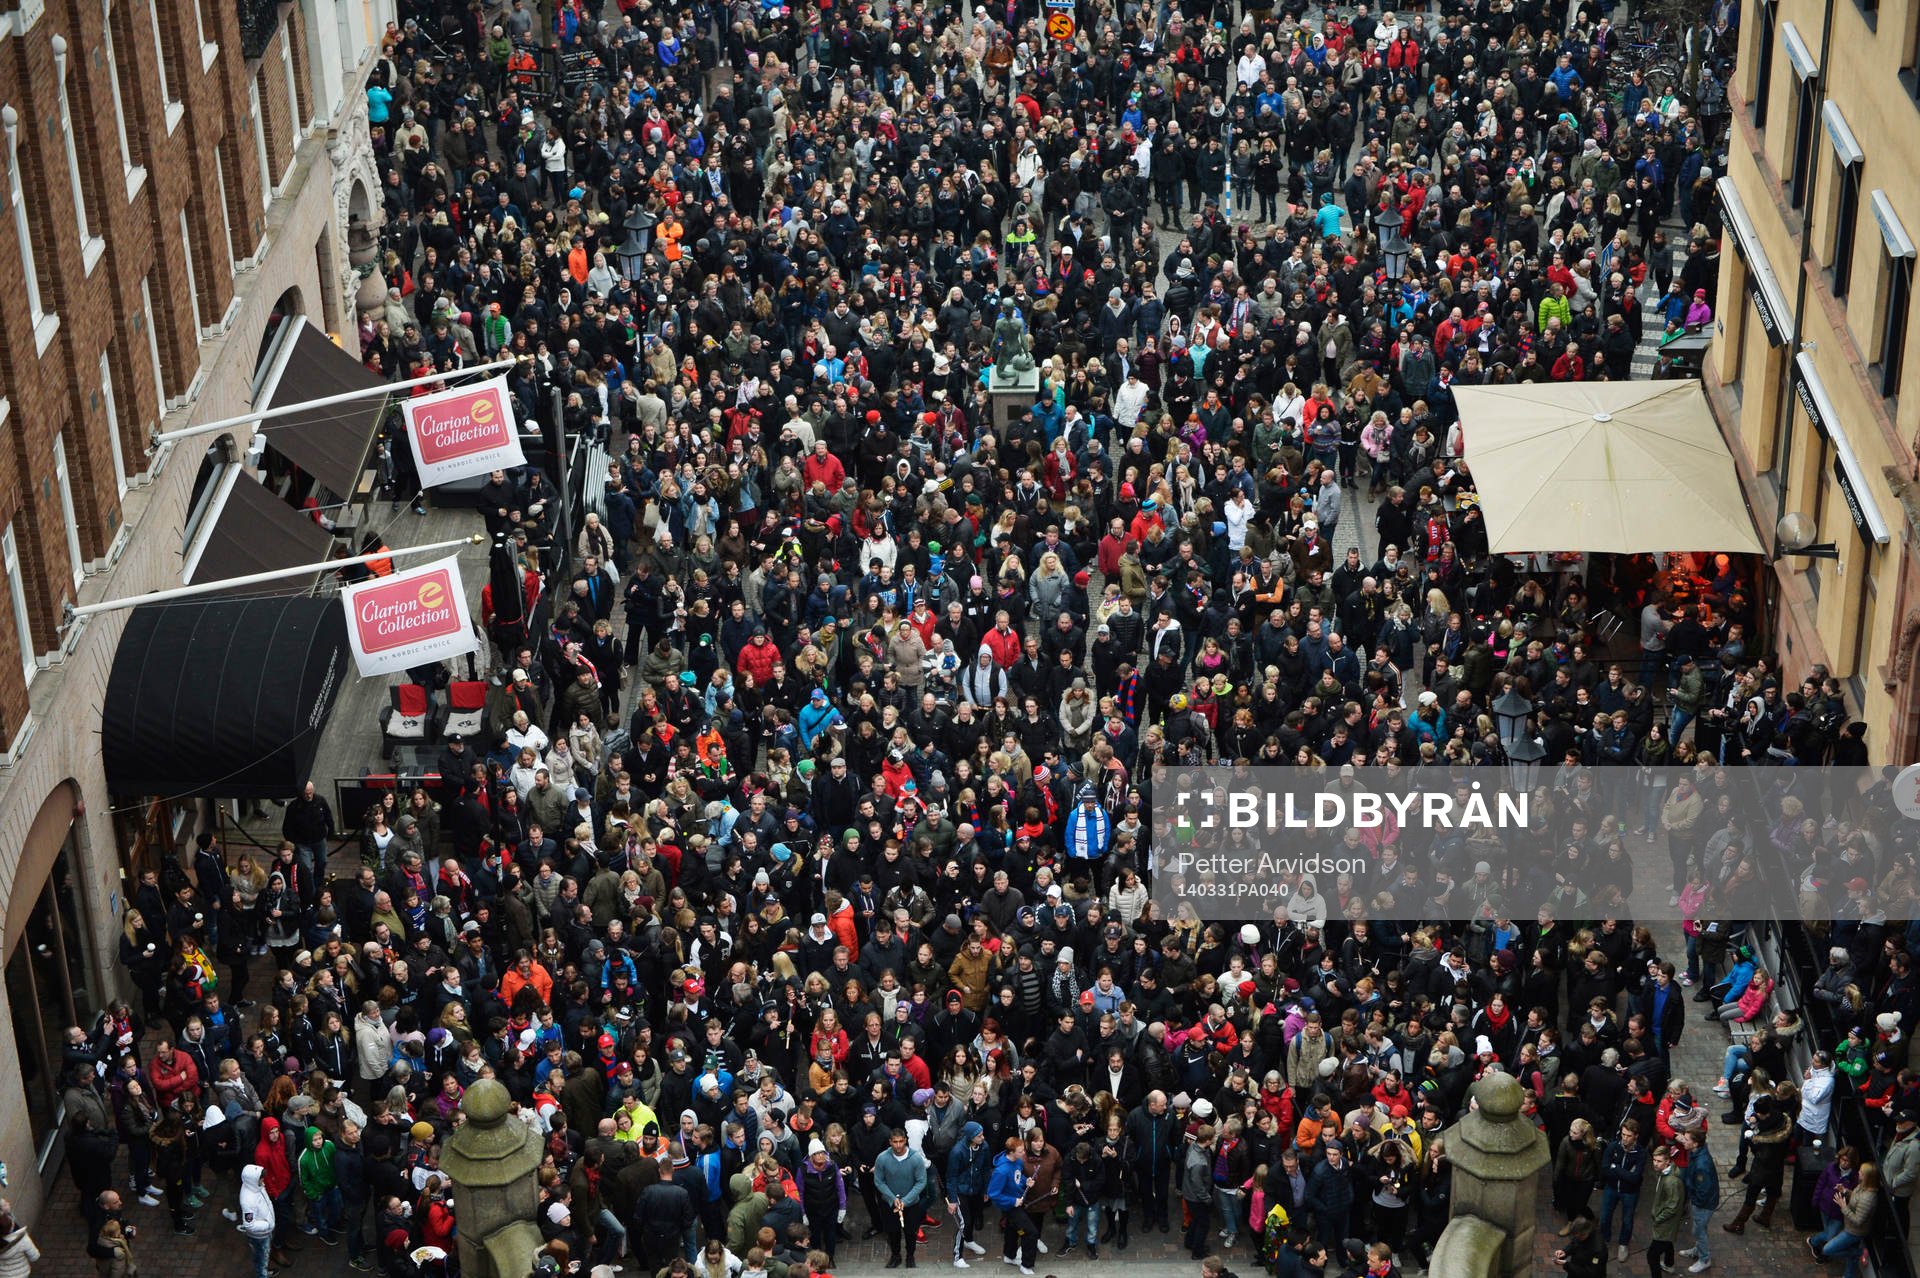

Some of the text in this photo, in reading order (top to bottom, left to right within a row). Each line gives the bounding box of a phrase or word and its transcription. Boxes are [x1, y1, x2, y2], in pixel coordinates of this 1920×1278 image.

[1753, 290, 1774, 331] KONTAKTCENTER
[1796, 378, 1820, 427] KONTAKTCENTER
[421, 415, 470, 437] Clarion
[435, 423, 500, 448] Collection
[448, 459, 473, 469] NORDIC
[476, 453, 501, 462] CHOICE
[1841, 476, 1863, 529] KONTAKTCENTER
[361, 599, 417, 623] Clarion
[377, 608, 449, 635] Collection
[392, 648, 419, 658] NORDIC
[424, 641, 452, 651] CHOICE
